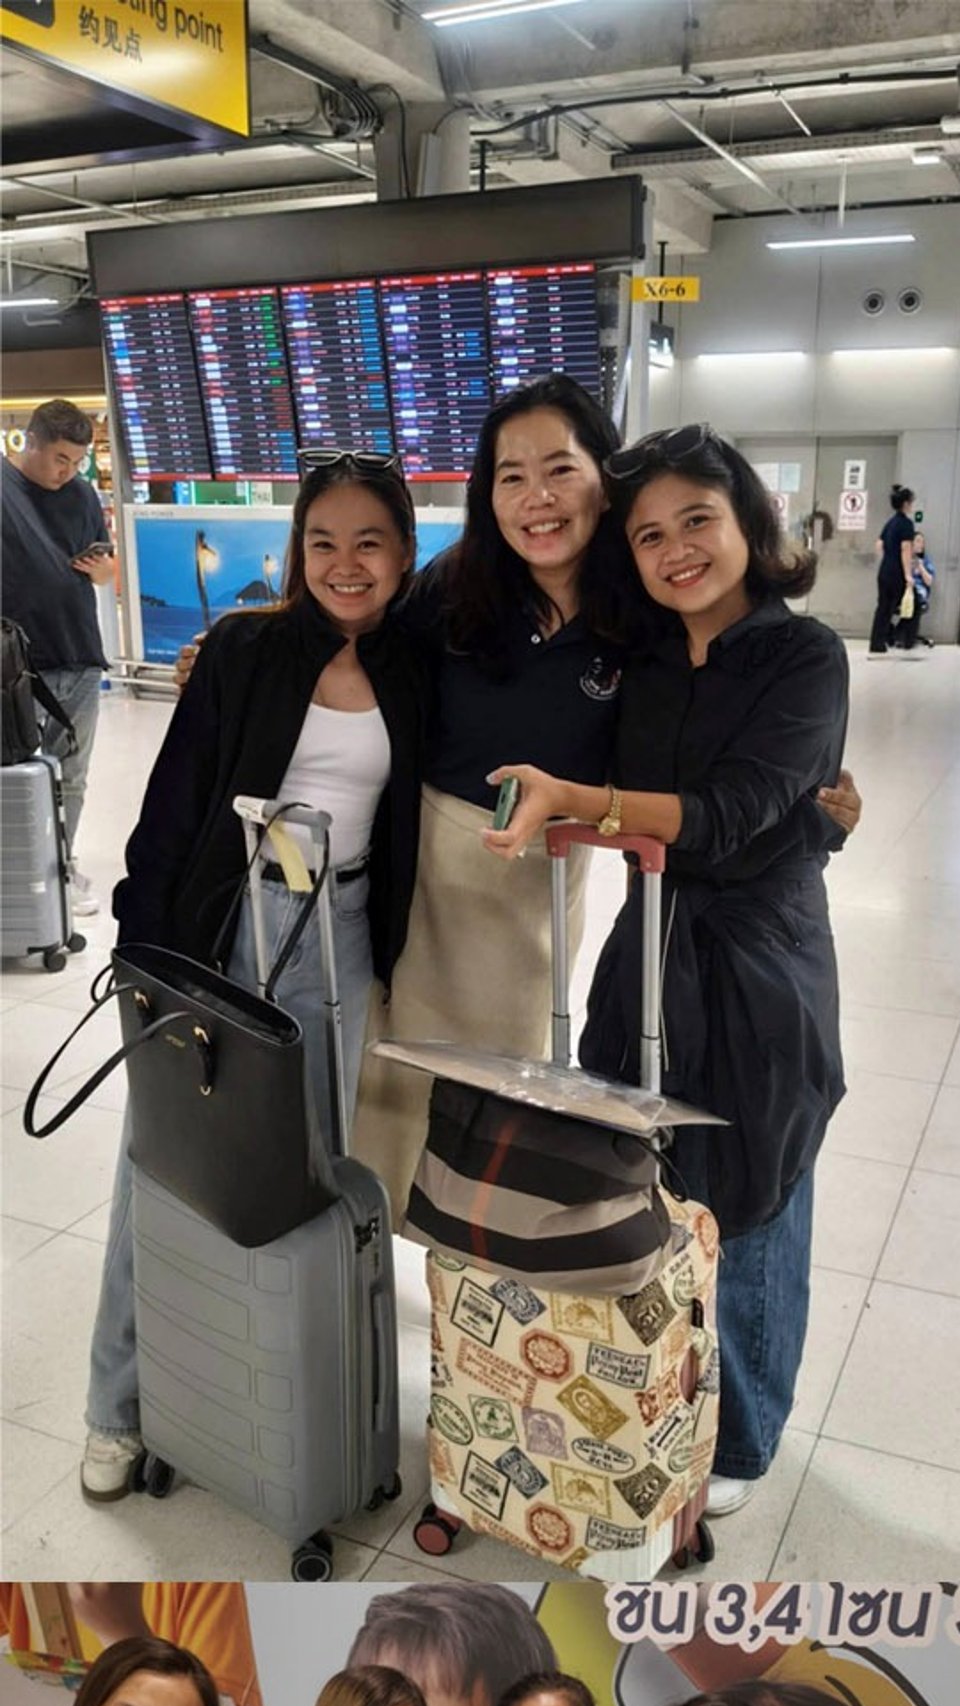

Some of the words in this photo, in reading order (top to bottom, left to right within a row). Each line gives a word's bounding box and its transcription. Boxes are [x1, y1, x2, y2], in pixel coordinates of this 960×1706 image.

[78, 5, 143, 62] 约见点
[174, 6, 224, 53] point
[644, 281, 686, 298] X6-6
[714, 1583, 802, 1643] 3,4
